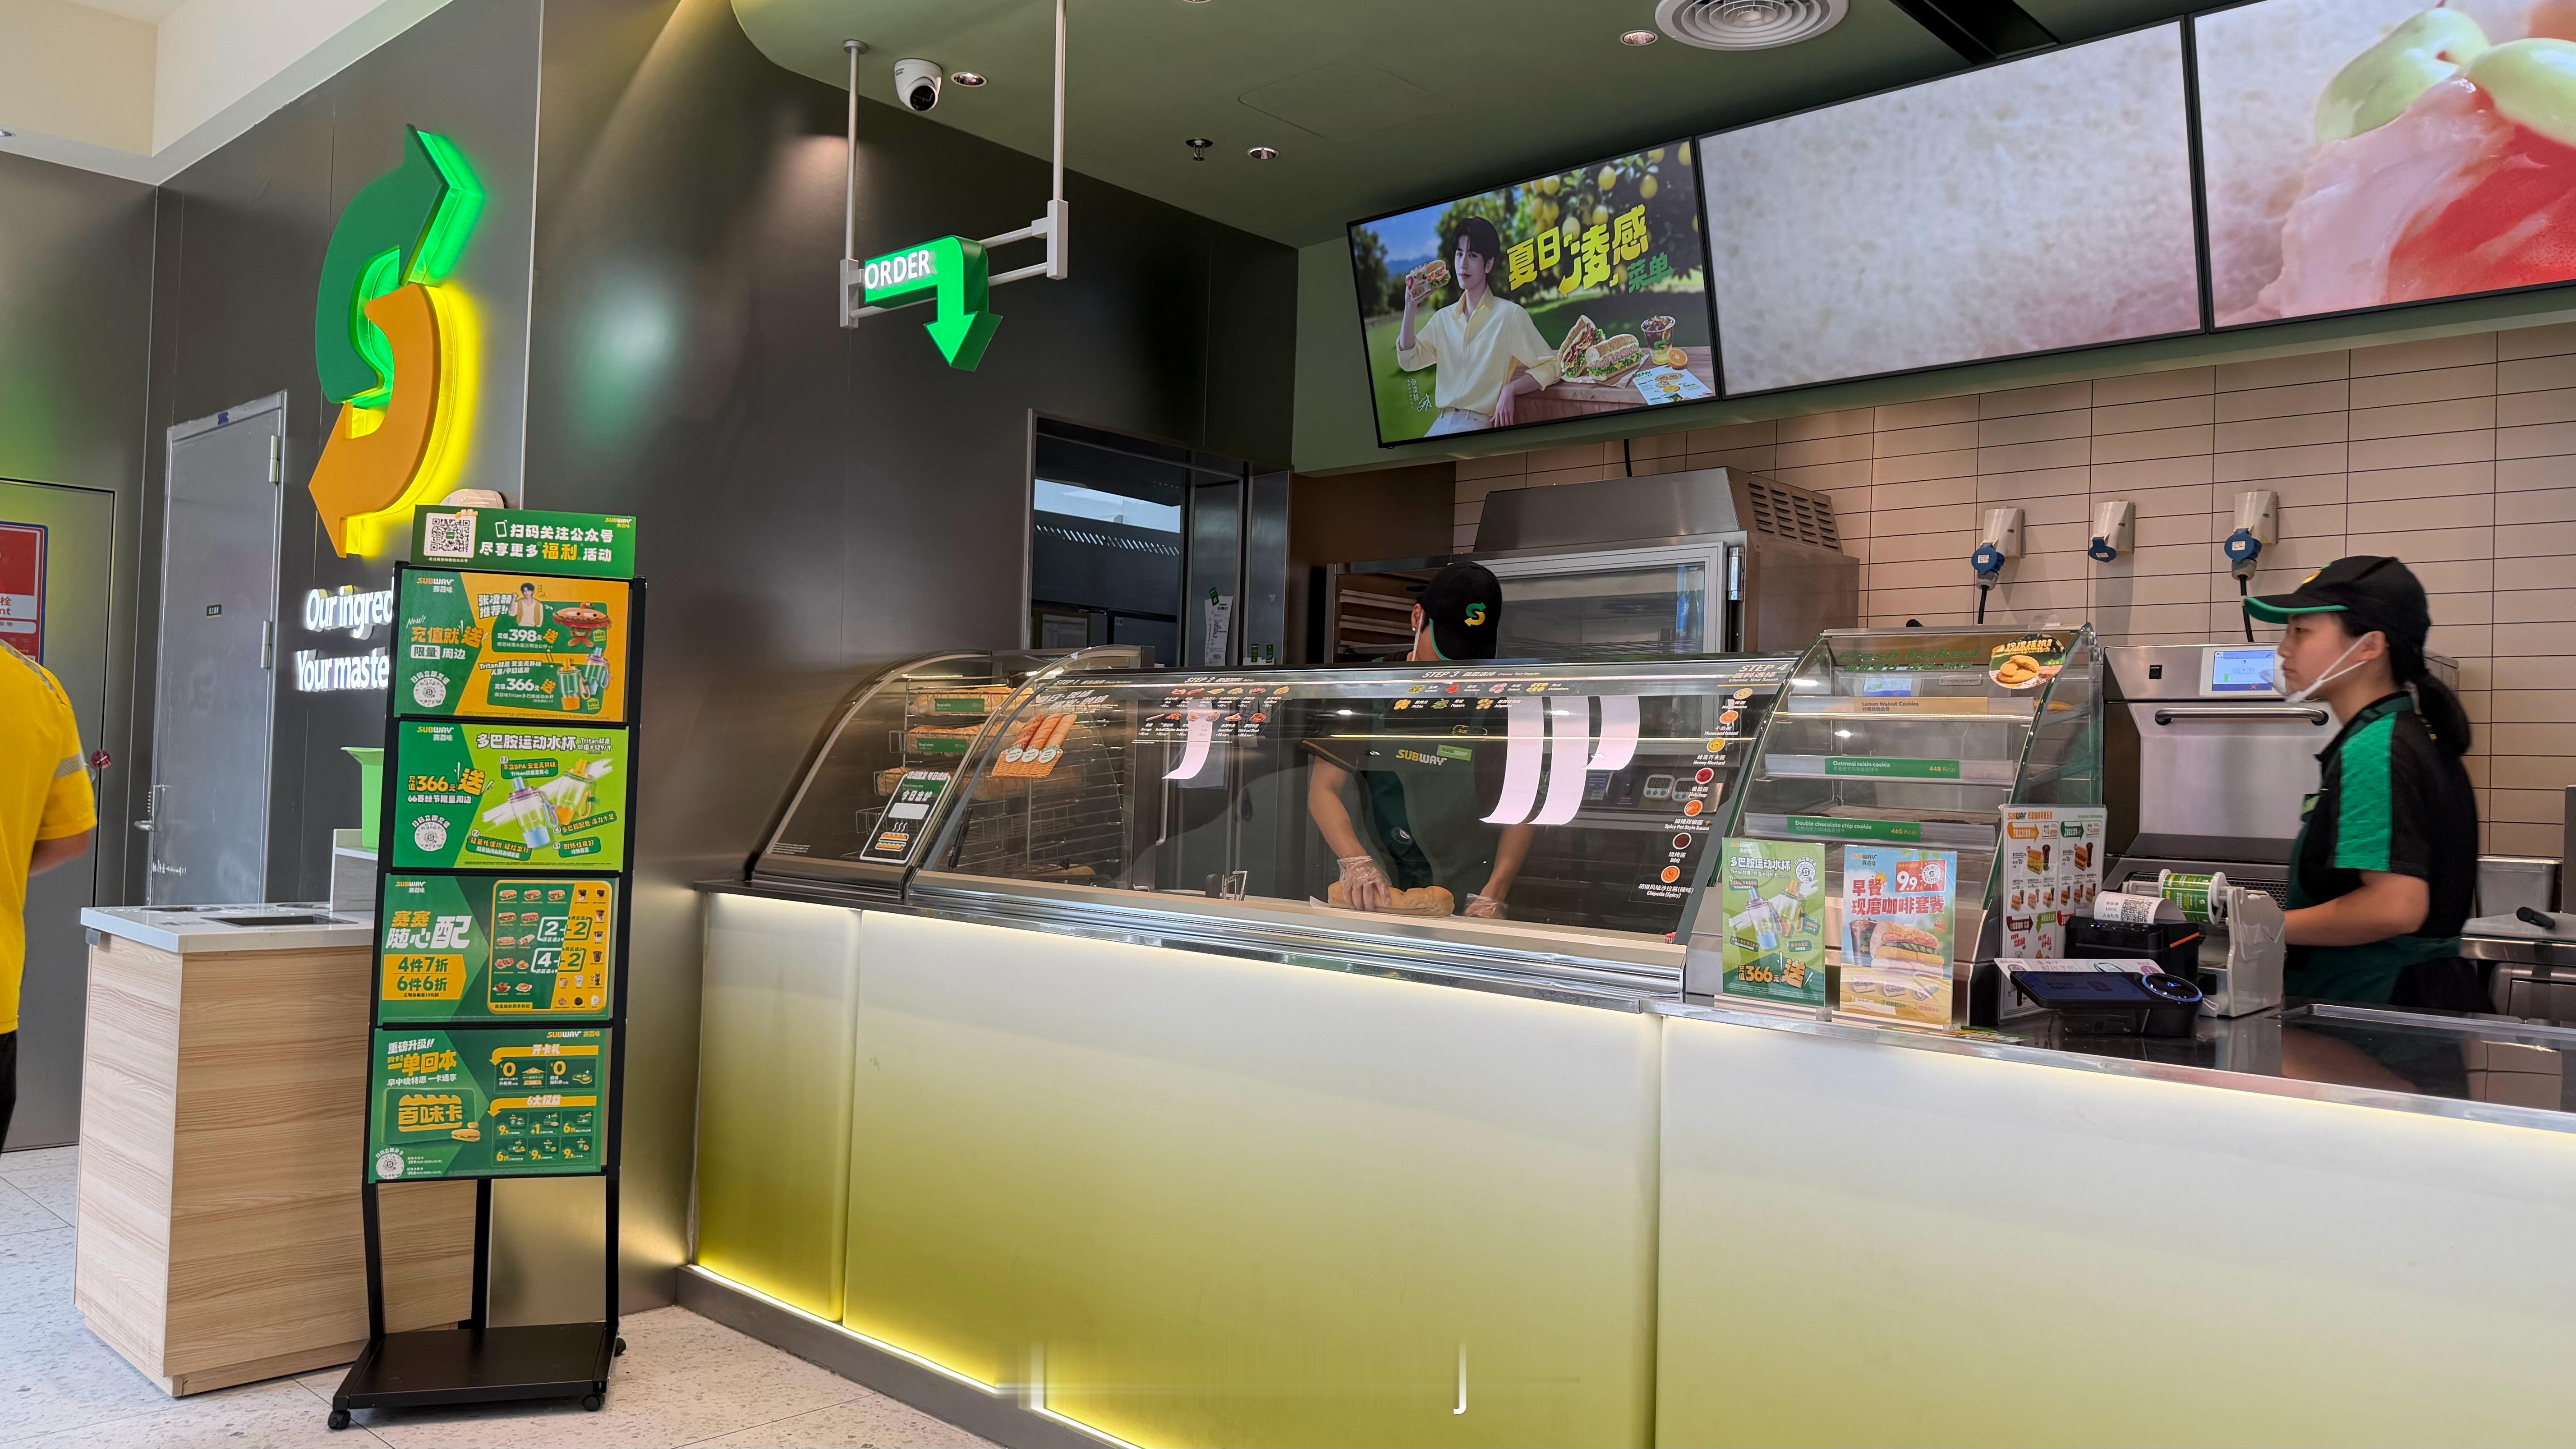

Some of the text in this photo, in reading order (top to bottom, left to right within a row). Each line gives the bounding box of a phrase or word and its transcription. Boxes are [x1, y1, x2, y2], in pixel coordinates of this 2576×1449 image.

[865, 249, 931, 289] ORDER
[510, 524, 613, 543] 扫码关注公众号
[479, 542, 612, 562] 尽享更多 福利 活动
[306, 589, 337, 630] Our
[411, 626, 484, 649] 充值就 送
[414, 647, 465, 659] 限量 周边
[1838, 647, 1982, 662] Fresh baked
[297, 650, 332, 691] Your
[476, 733, 576, 750] 多巴胺运动水杯
[1396, 749, 1448, 765] SUBWAY
[458, 768, 486, 795] 送
[902, 790, 933, 801] 今日出炉
[1730, 856, 1791, 871] 多巴胺运动水杯
[1852, 879, 1882, 896] 早餐
[1897, 871, 1918, 891] 9.9
[1851, 896, 1945, 915] 现磨咖啡套餐
[391, 911, 431, 927] 赛赛
[386, 915, 472, 948] 随心配
[398, 957, 448, 972] 4件7折
[1782, 959, 1805, 988] 送
[397, 975, 448, 991] 6件6折
[388, 1038, 435, 1054] 重磅升级!!
[388, 1049, 457, 1076] 一单回本
[387, 1076, 427, 1086] 早中晚特惠
[398, 1105, 462, 1125] 百味卡
